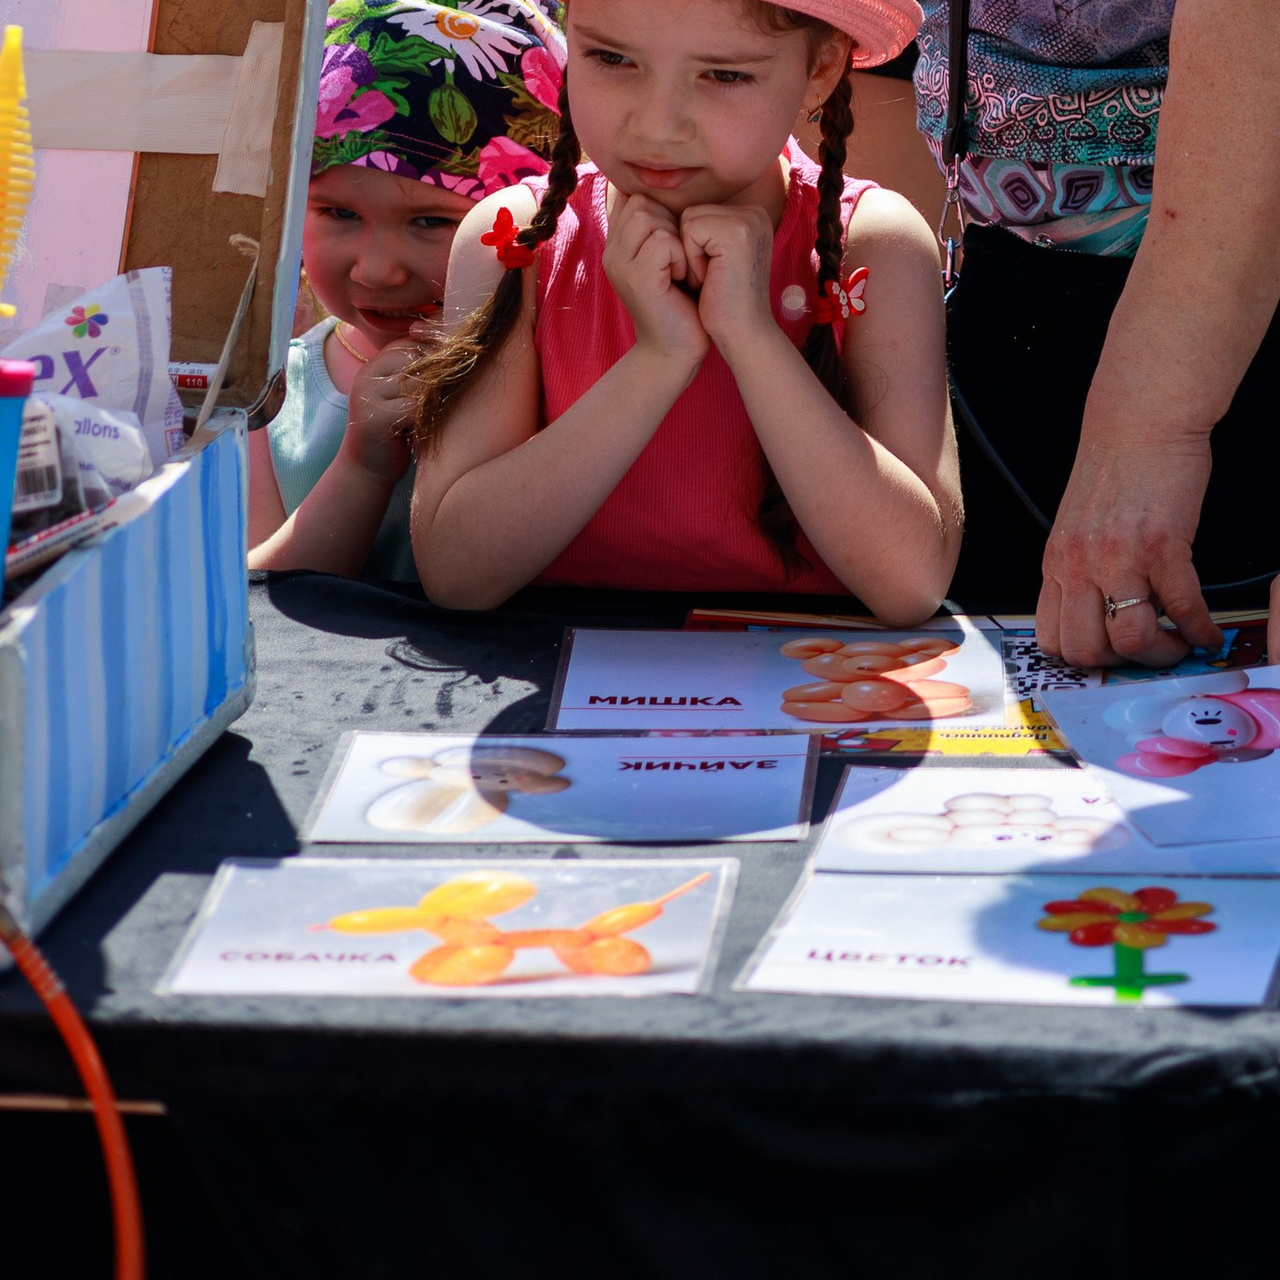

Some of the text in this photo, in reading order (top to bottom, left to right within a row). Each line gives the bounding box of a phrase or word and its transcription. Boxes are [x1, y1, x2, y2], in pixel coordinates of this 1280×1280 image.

[185, 377, 203, 388] 110
[588, 695, 743, 708] МИШКА
[617, 759, 778, 773] ЗАЙЧИК
[218, 950, 397, 965] СОБАЧКА
[807, 948, 972, 969] ЦВЕТОК
